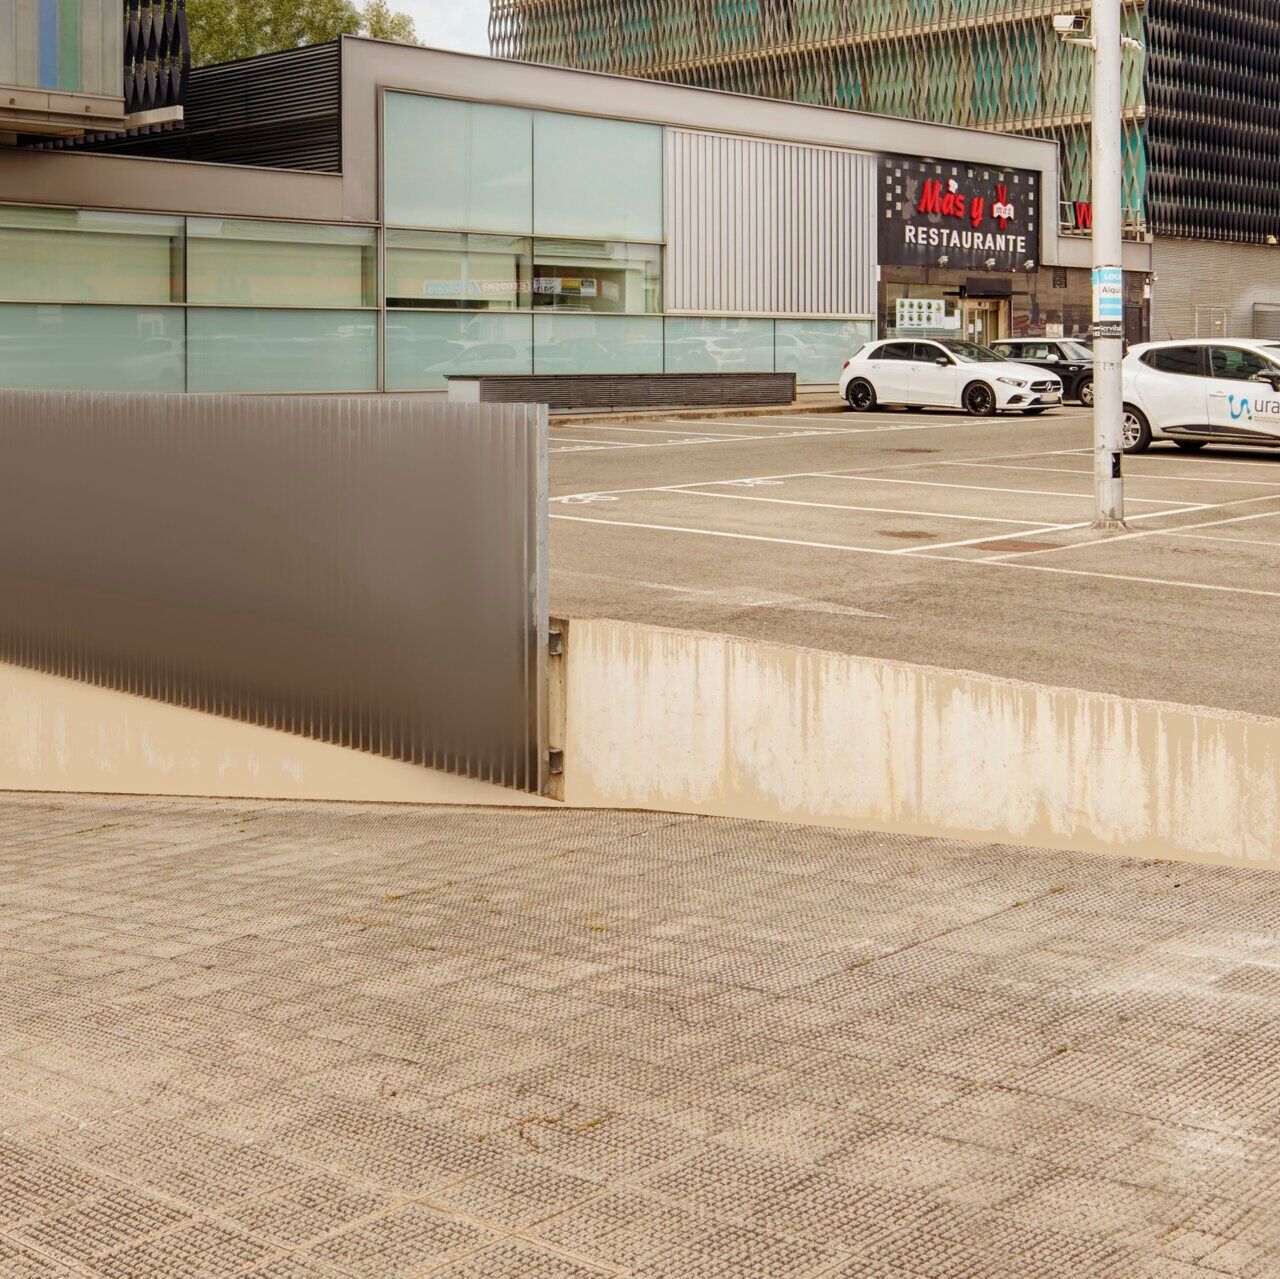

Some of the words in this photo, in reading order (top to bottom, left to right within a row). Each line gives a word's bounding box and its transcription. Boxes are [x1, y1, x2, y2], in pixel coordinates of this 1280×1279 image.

[971, 197, 985, 229] y
[904, 225, 1026, 253] RESTAURANTE
[1254, 399, 1280, 414] ura
